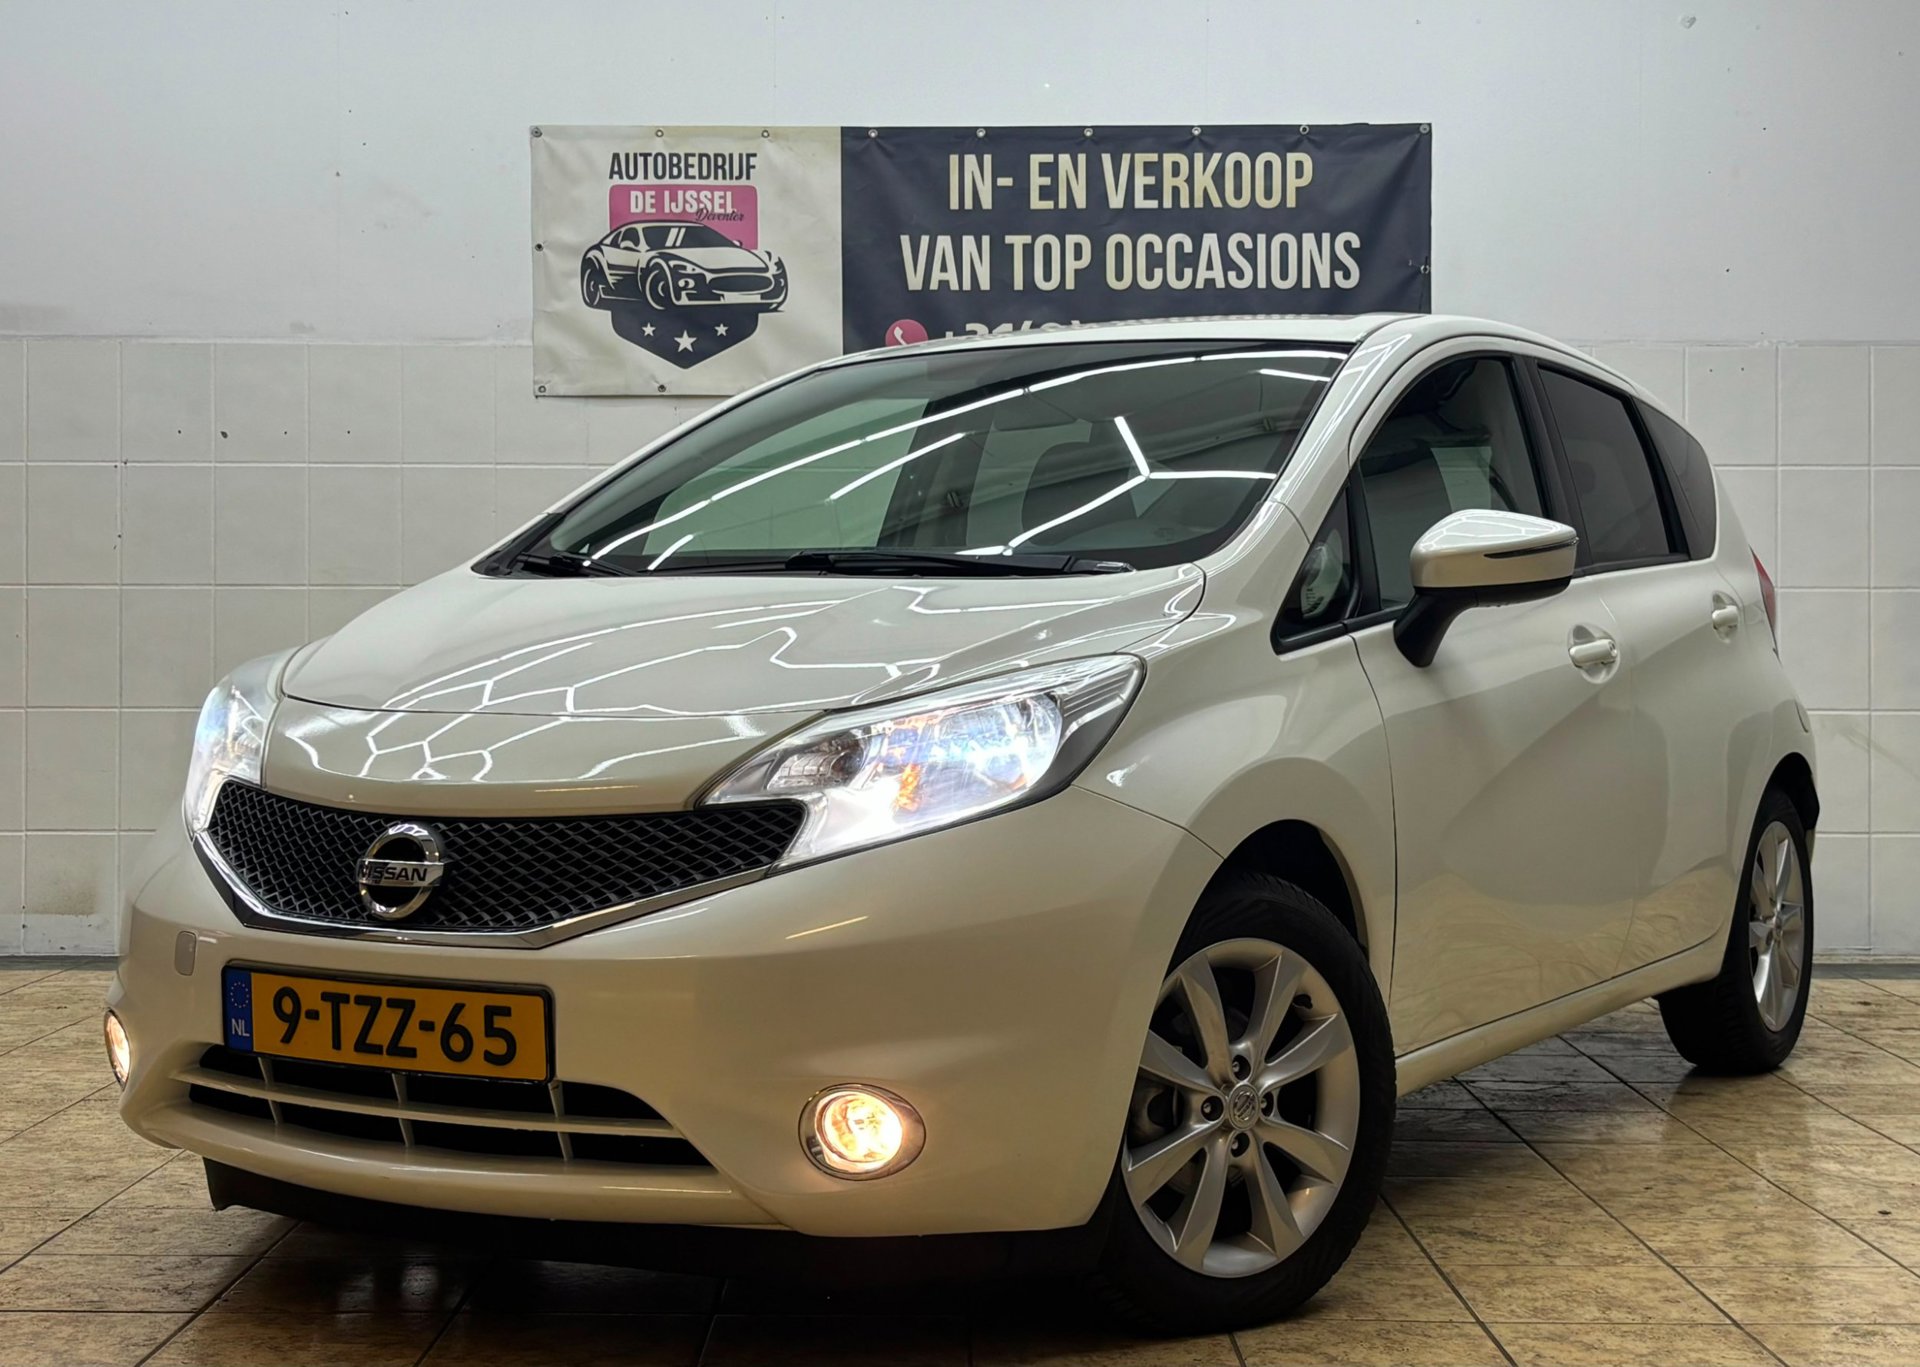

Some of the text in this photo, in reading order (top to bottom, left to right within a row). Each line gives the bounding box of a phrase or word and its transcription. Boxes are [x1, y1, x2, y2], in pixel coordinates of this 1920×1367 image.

[609, 152, 757, 180] AUTOBEDRIJF
[949, 152, 1313, 210] IN- EN VERKOOP
[630, 190, 735, 213] DE IJSSEL
[695, 206, 744, 222] Deventer
[900, 232, 1361, 291] VAN TOP OCCASIONS
[358, 865, 427, 881] NISSAN
[231, 1019, 250, 1036] NL
[273, 987, 517, 1066] 9-TZZ-65
